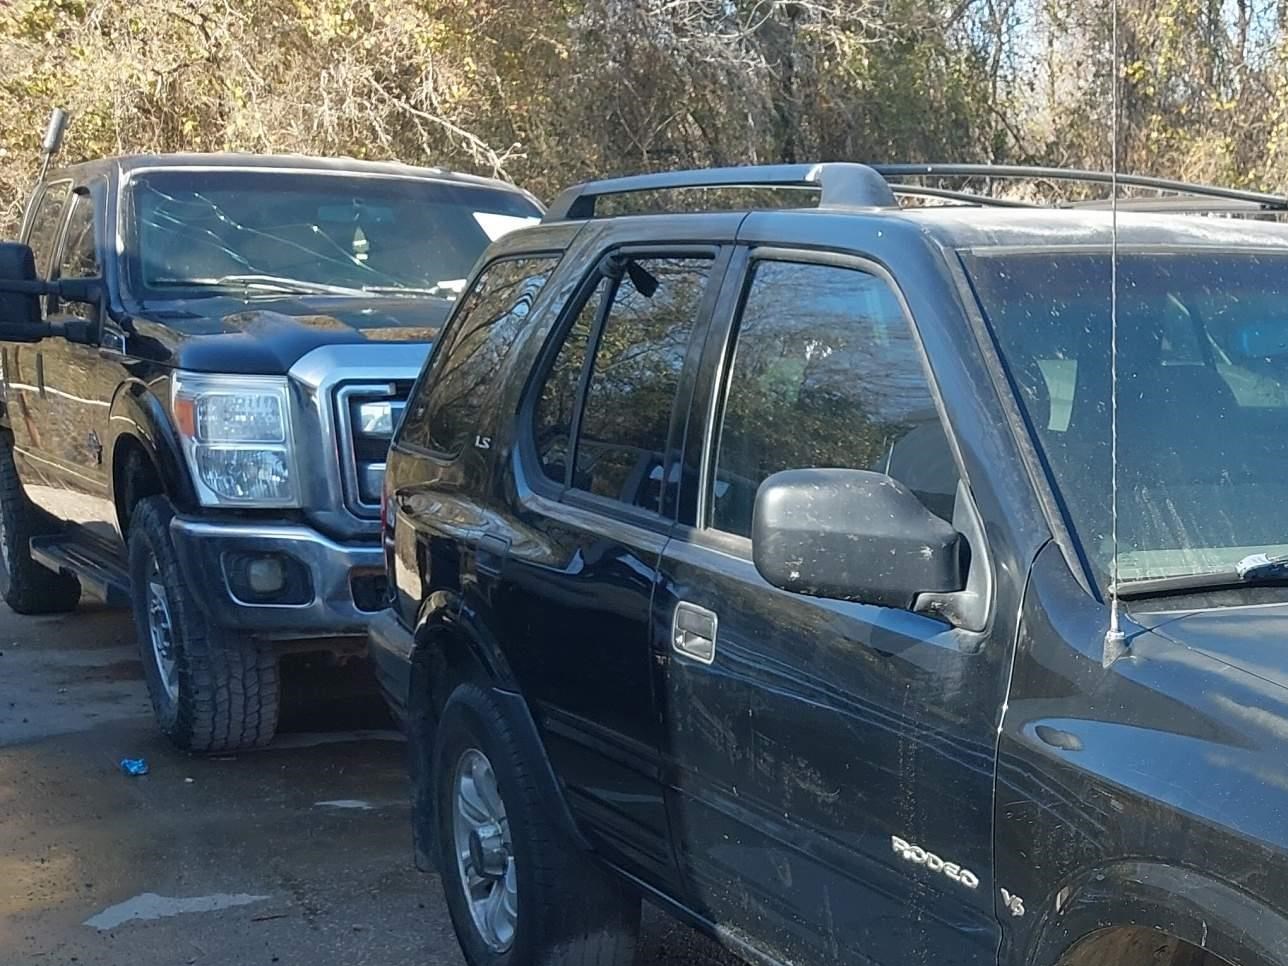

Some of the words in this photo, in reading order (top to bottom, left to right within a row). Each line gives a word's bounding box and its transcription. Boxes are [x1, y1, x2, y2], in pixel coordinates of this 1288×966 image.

[474, 435, 492, 449] LS
[891, 834, 980, 889] RODEO
[1000, 887, 1026, 917] V6
